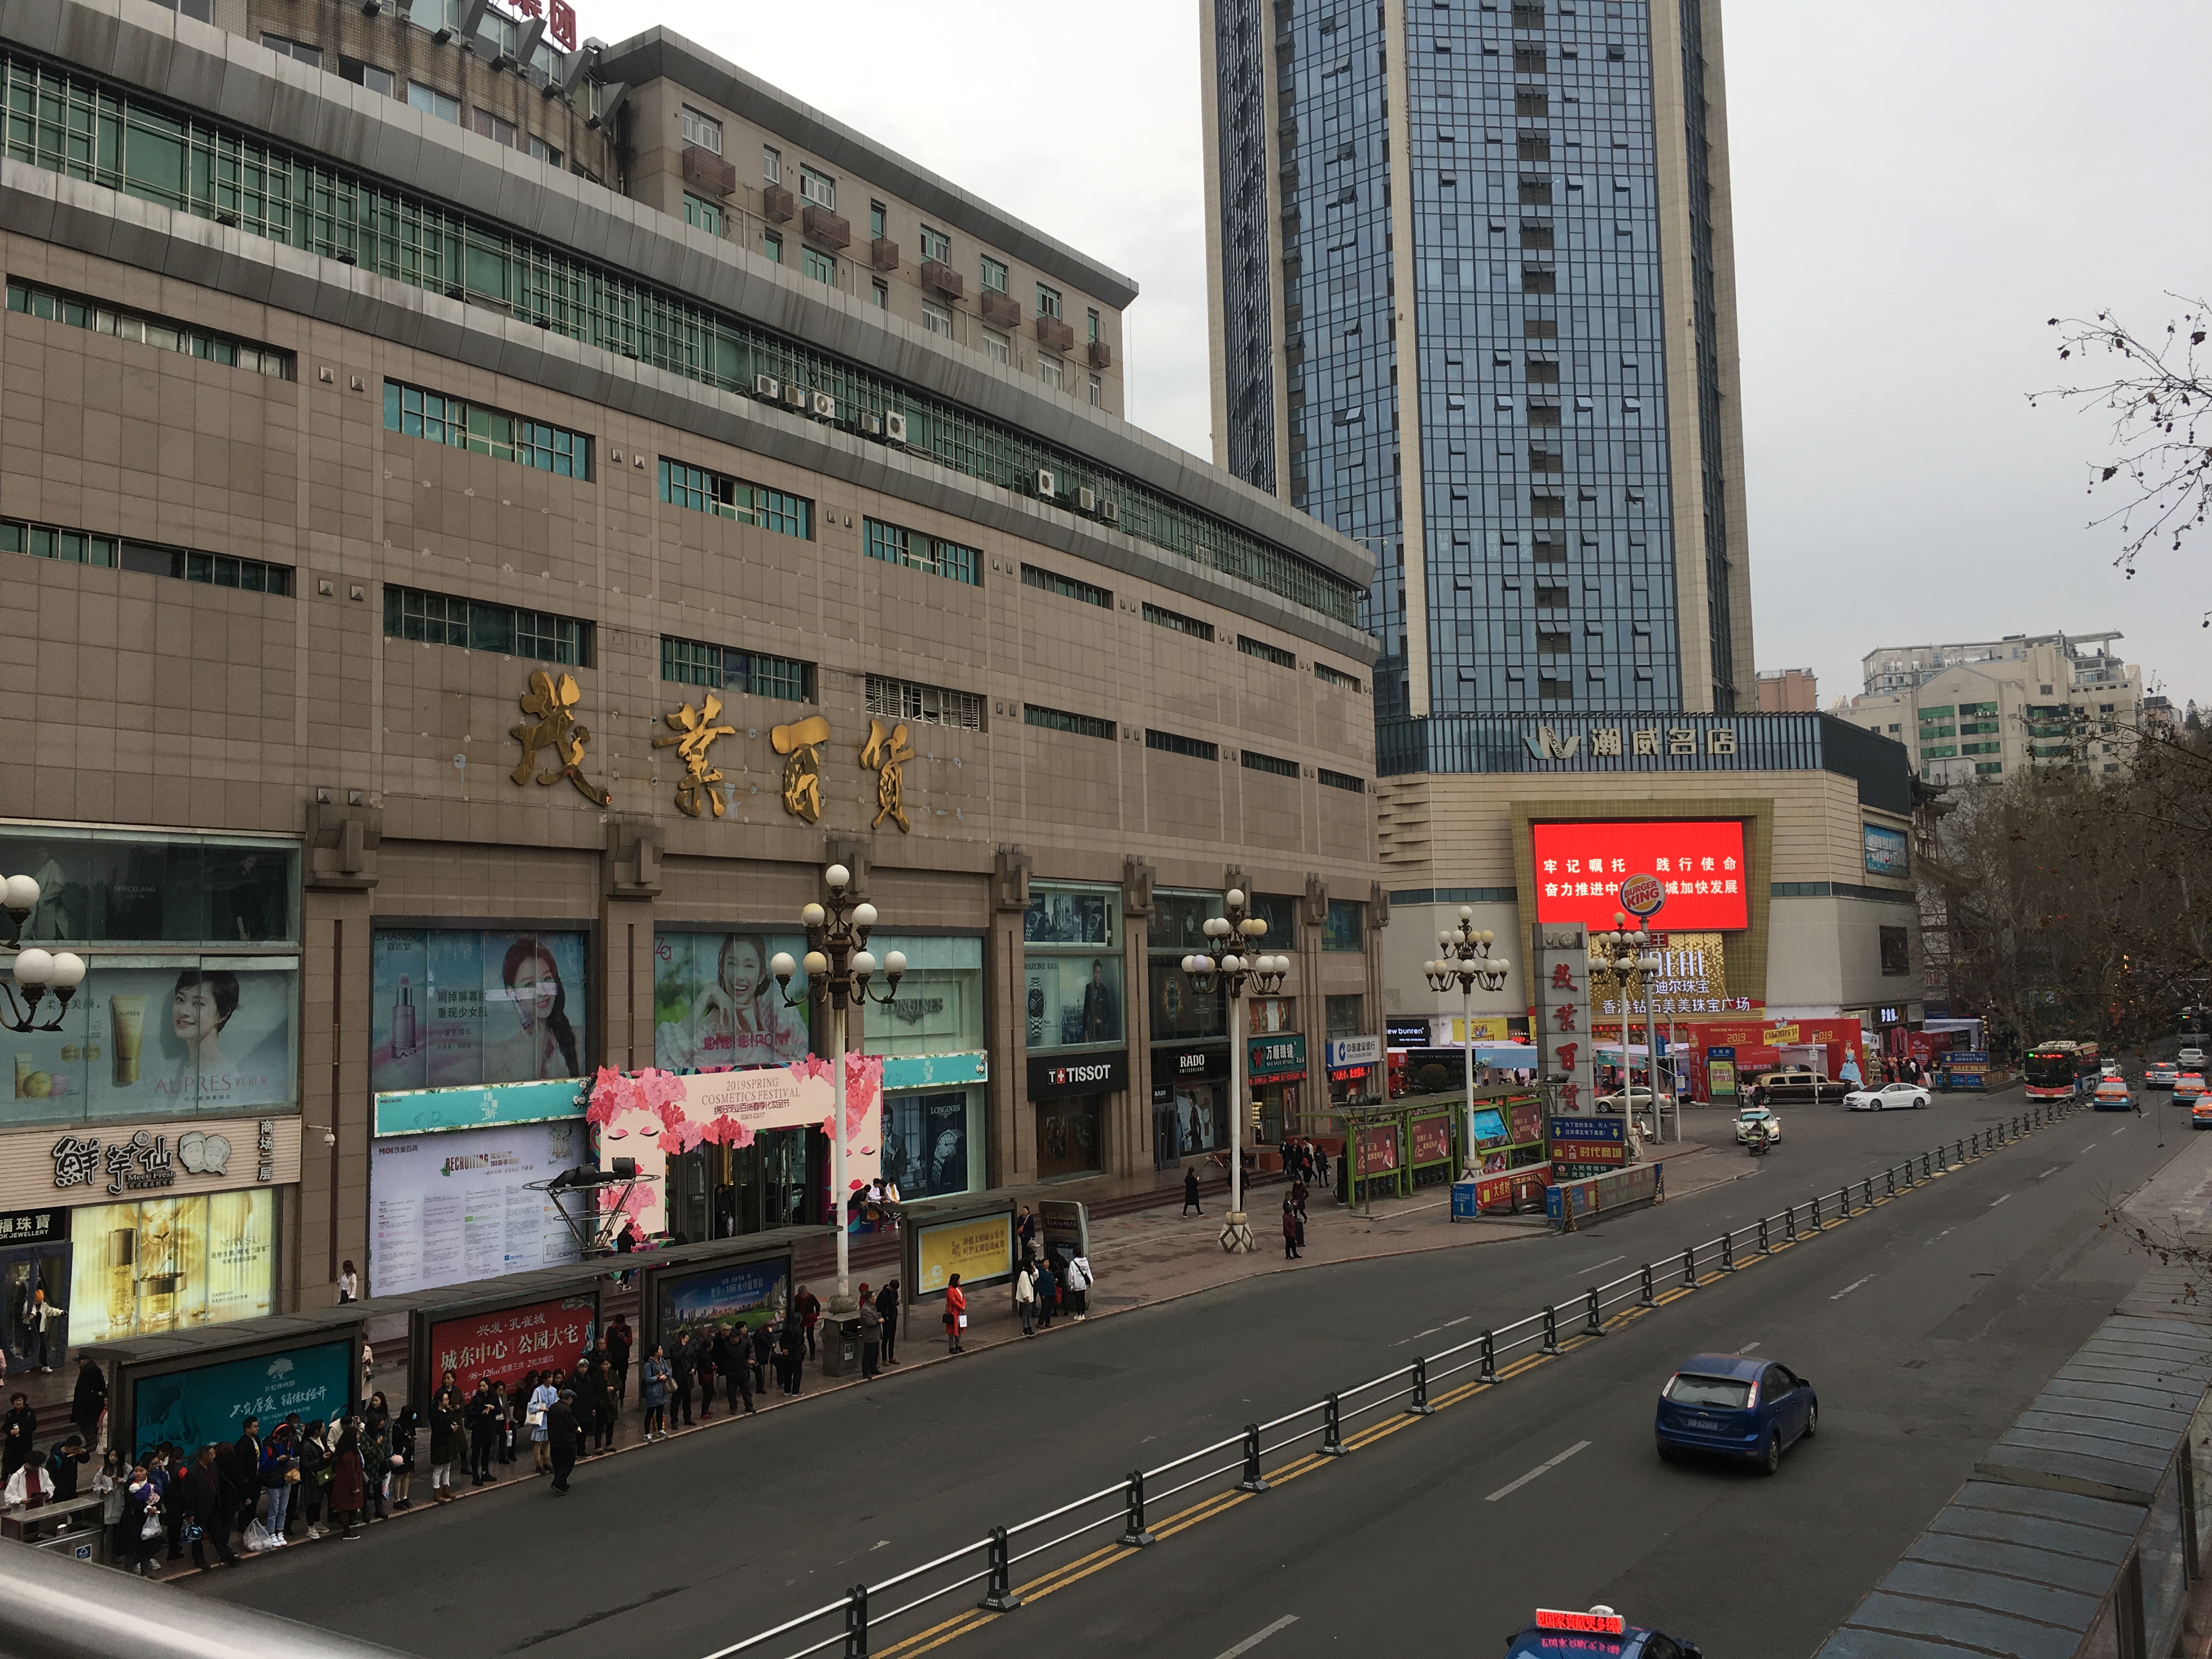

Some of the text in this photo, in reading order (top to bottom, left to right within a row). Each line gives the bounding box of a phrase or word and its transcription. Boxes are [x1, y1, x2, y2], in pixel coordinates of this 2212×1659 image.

[1544, 727, 1564, 759] HONG WEI
[1592, 727, 1737, 756] 瀚威名店
[1543, 856, 1737, 873] 牢记嘱托 践行使命
[1544, 879, 1739, 897] 奋力推进中城加快发展
[1624, 881, 1657, 899] BURGER
[1626, 888, 1660, 910] KING
[387, 942, 411, 951] 自然堂
[654, 936, 672, 960] Za
[1640, 950, 1709, 977] DEAL
[1642, 979, 1711, 995] 迪尔珠宝
[437, 1007, 488, 1018] 重现少女肌
[880, 997, 944, 1014] LONGINES
[1726, 1032, 1746, 1042] 2019
[1266, 1043, 1294, 1060] 万顺眼镜
[1346, 1041, 1375, 1052] 中国建设银行
[1180, 1054, 1205, 1068] RADO
[1066, 1064, 1111, 1082] TISSOT
[154, 1074, 232, 1094] AUPRES
[726, 1077, 778, 1091] 2019SPRING
[702, 1087, 801, 1105] COSMETICS FESTIVAL
[714, 1098, 790, 1115] 绵阳茂业百货春季化妆品节
[930, 1104, 961, 1114] LONGINES
[258, 1119, 274, 1181] 商场二层
[1568, 1144, 1622, 1160] 大成 时代商城
[445, 1153, 489, 1172] RECRUITING
[153, 1171, 177, 1179] Fresh
[9, 1229, 49, 1238] JEWELLERY
[441, 1324, 579, 1372] 城东中心 公园大宅
